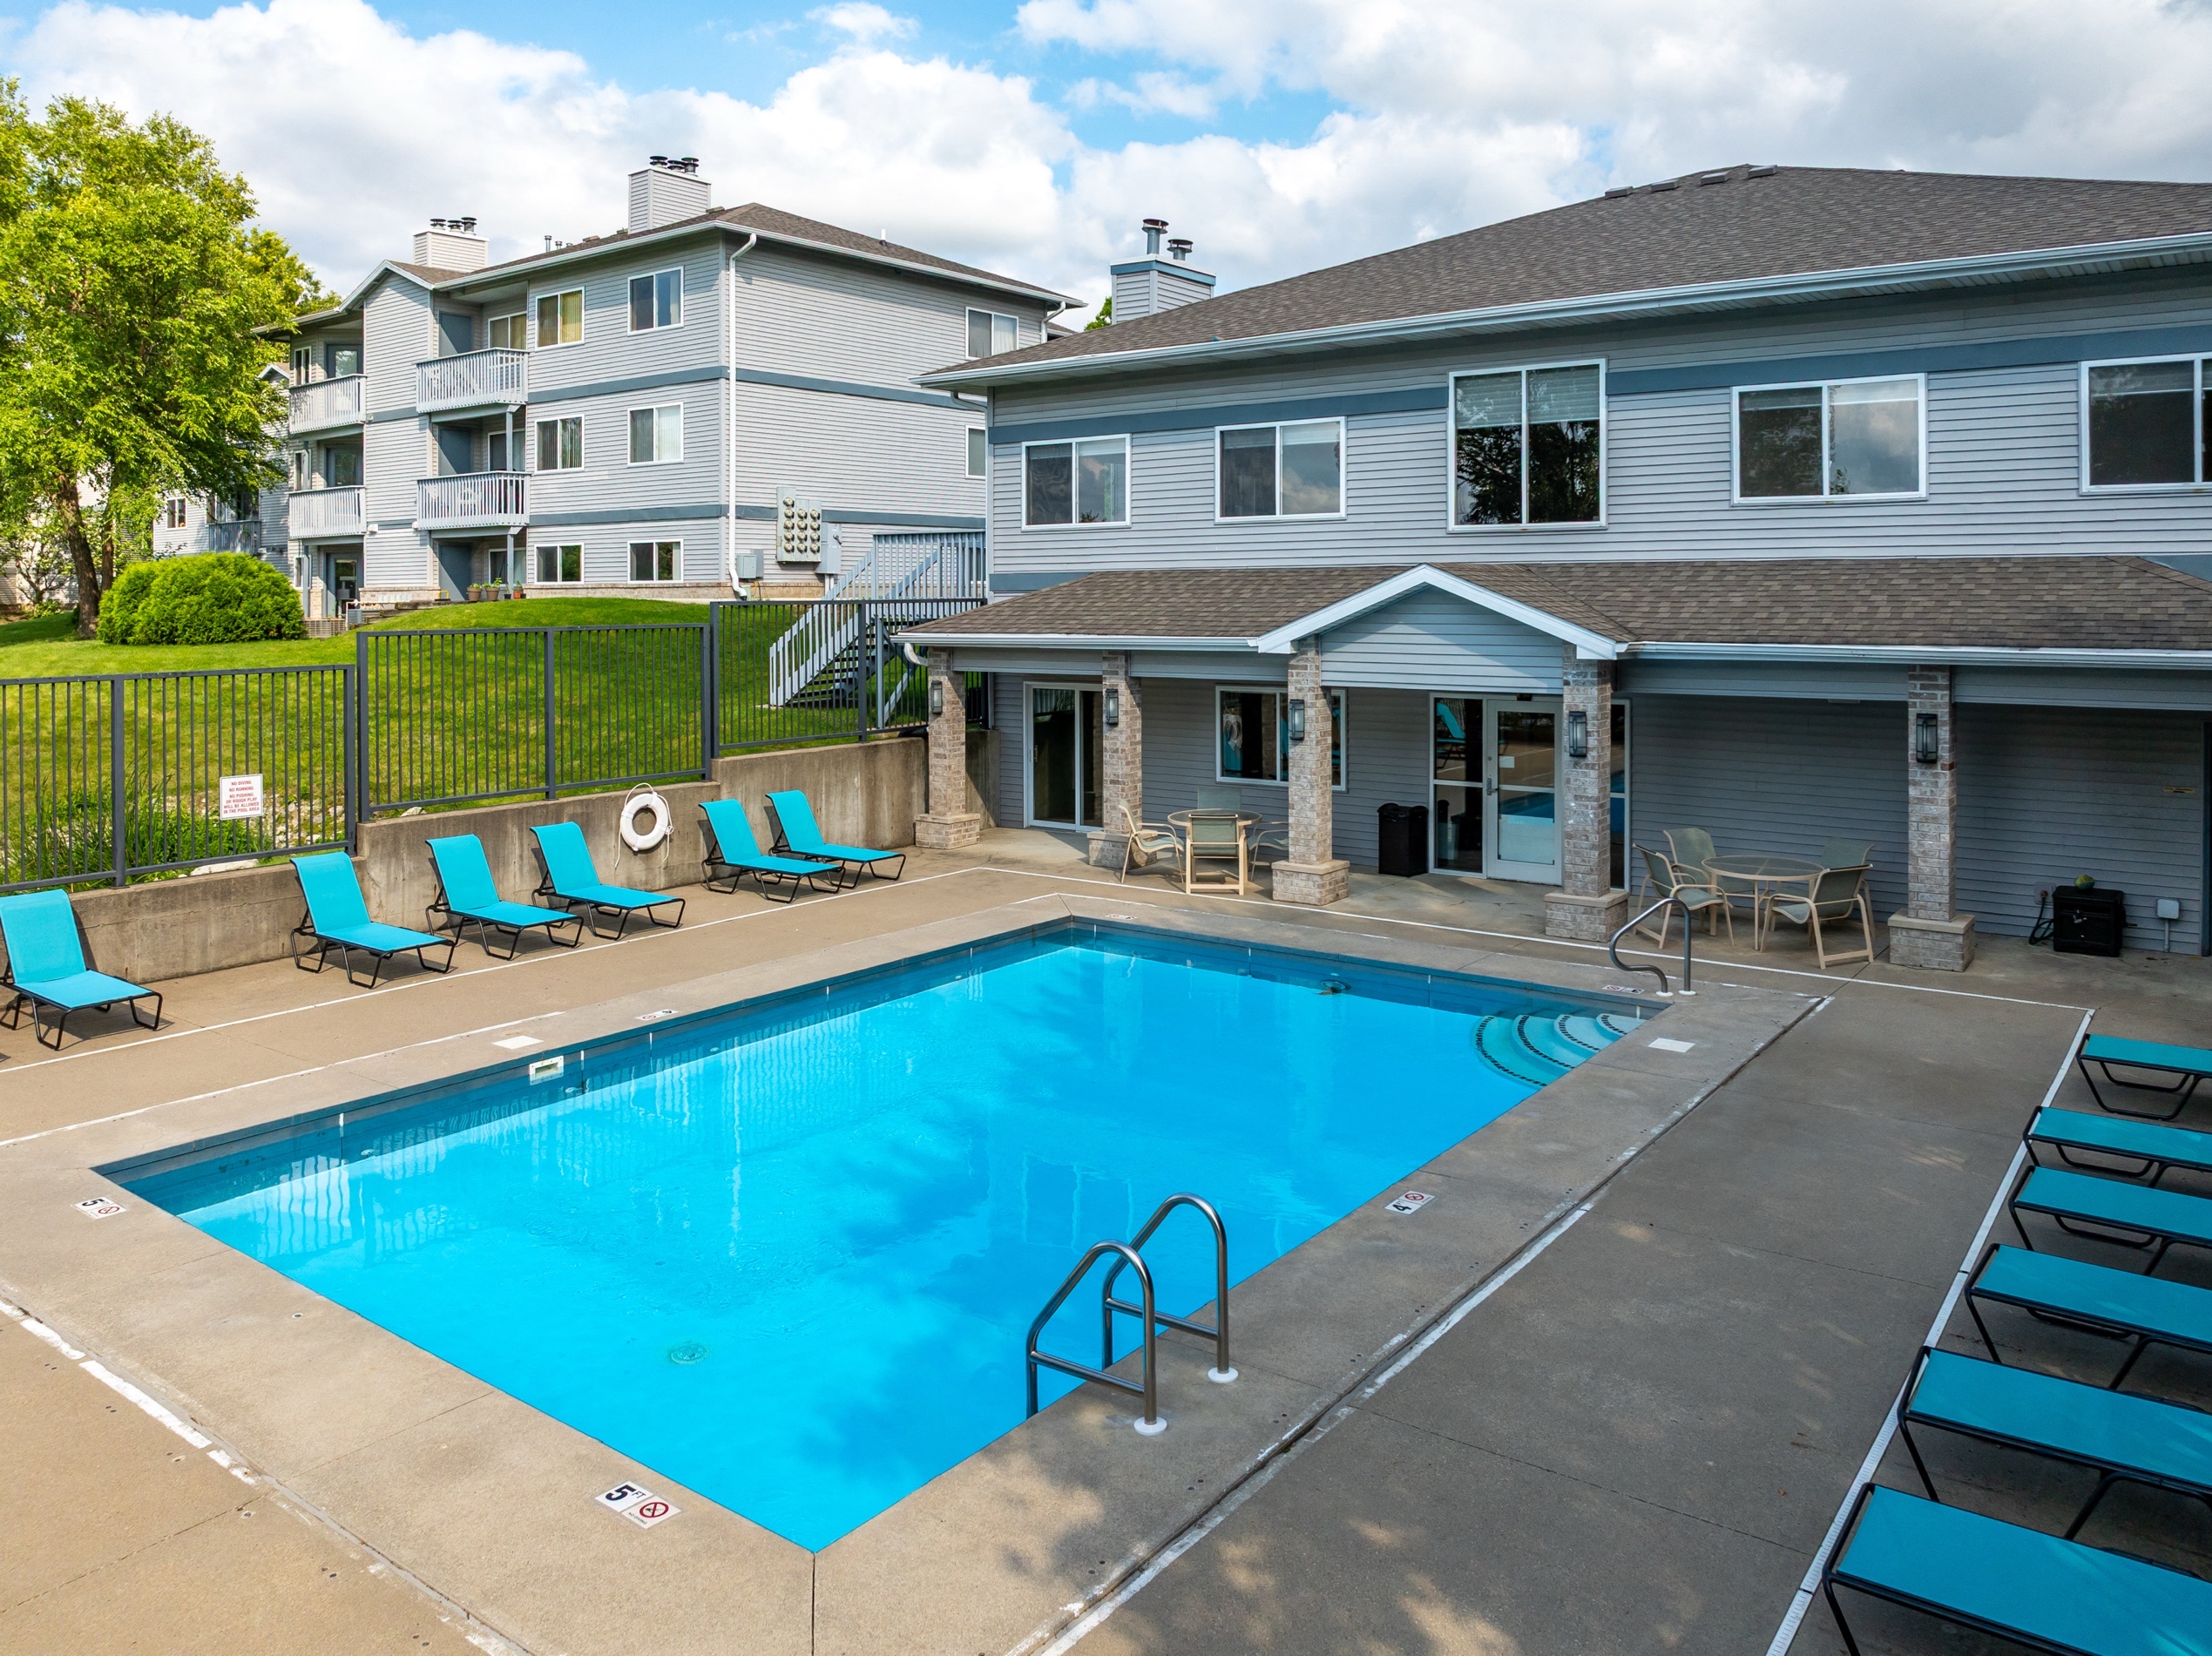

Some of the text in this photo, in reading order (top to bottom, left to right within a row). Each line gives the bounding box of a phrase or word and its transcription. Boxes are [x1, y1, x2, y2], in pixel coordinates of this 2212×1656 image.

[82, 1198, 105, 1207] 5
[605, 1484, 637, 1501] 5
[633, 1515, 647, 1525] DIVING
